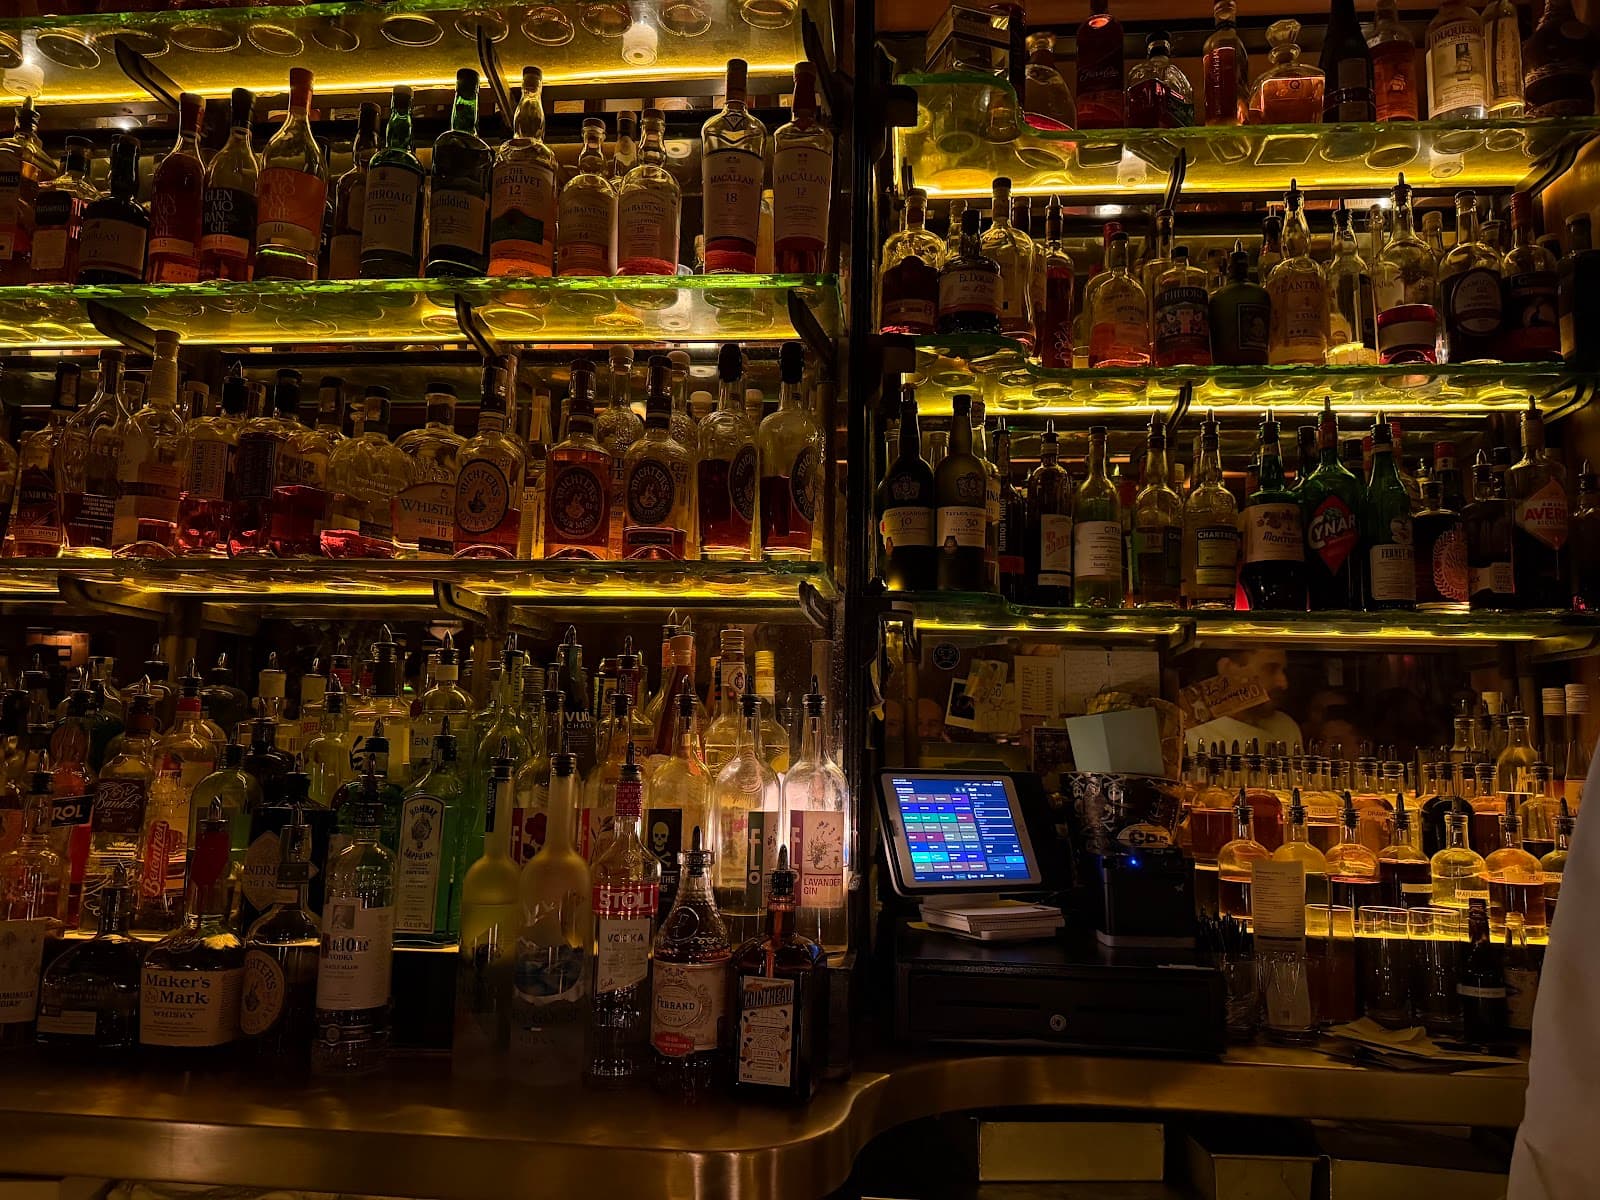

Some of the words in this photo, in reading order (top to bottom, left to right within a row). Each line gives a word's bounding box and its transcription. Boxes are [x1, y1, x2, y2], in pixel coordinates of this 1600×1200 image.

[710, 175, 754, 185] MACALLAN
[777, 172, 827, 185] MACALLAN
[509, 185, 521, 195] 12
[726, 192, 738, 203] 18
[211, 201, 234, 212] MO
[965, 518, 978, 528] 30
[1307, 513, 1356, 549] CYNAR
[51, 804, 84, 821] ROL
[409, 805, 438, 818] BOMBAY
[803, 887, 818, 895] GIN
[599, 889, 654, 910] STOLI
[607, 933, 644, 943] VODKA
[146, 973, 211, 988] Maker's
[160, 990, 209, 1004] Mark
